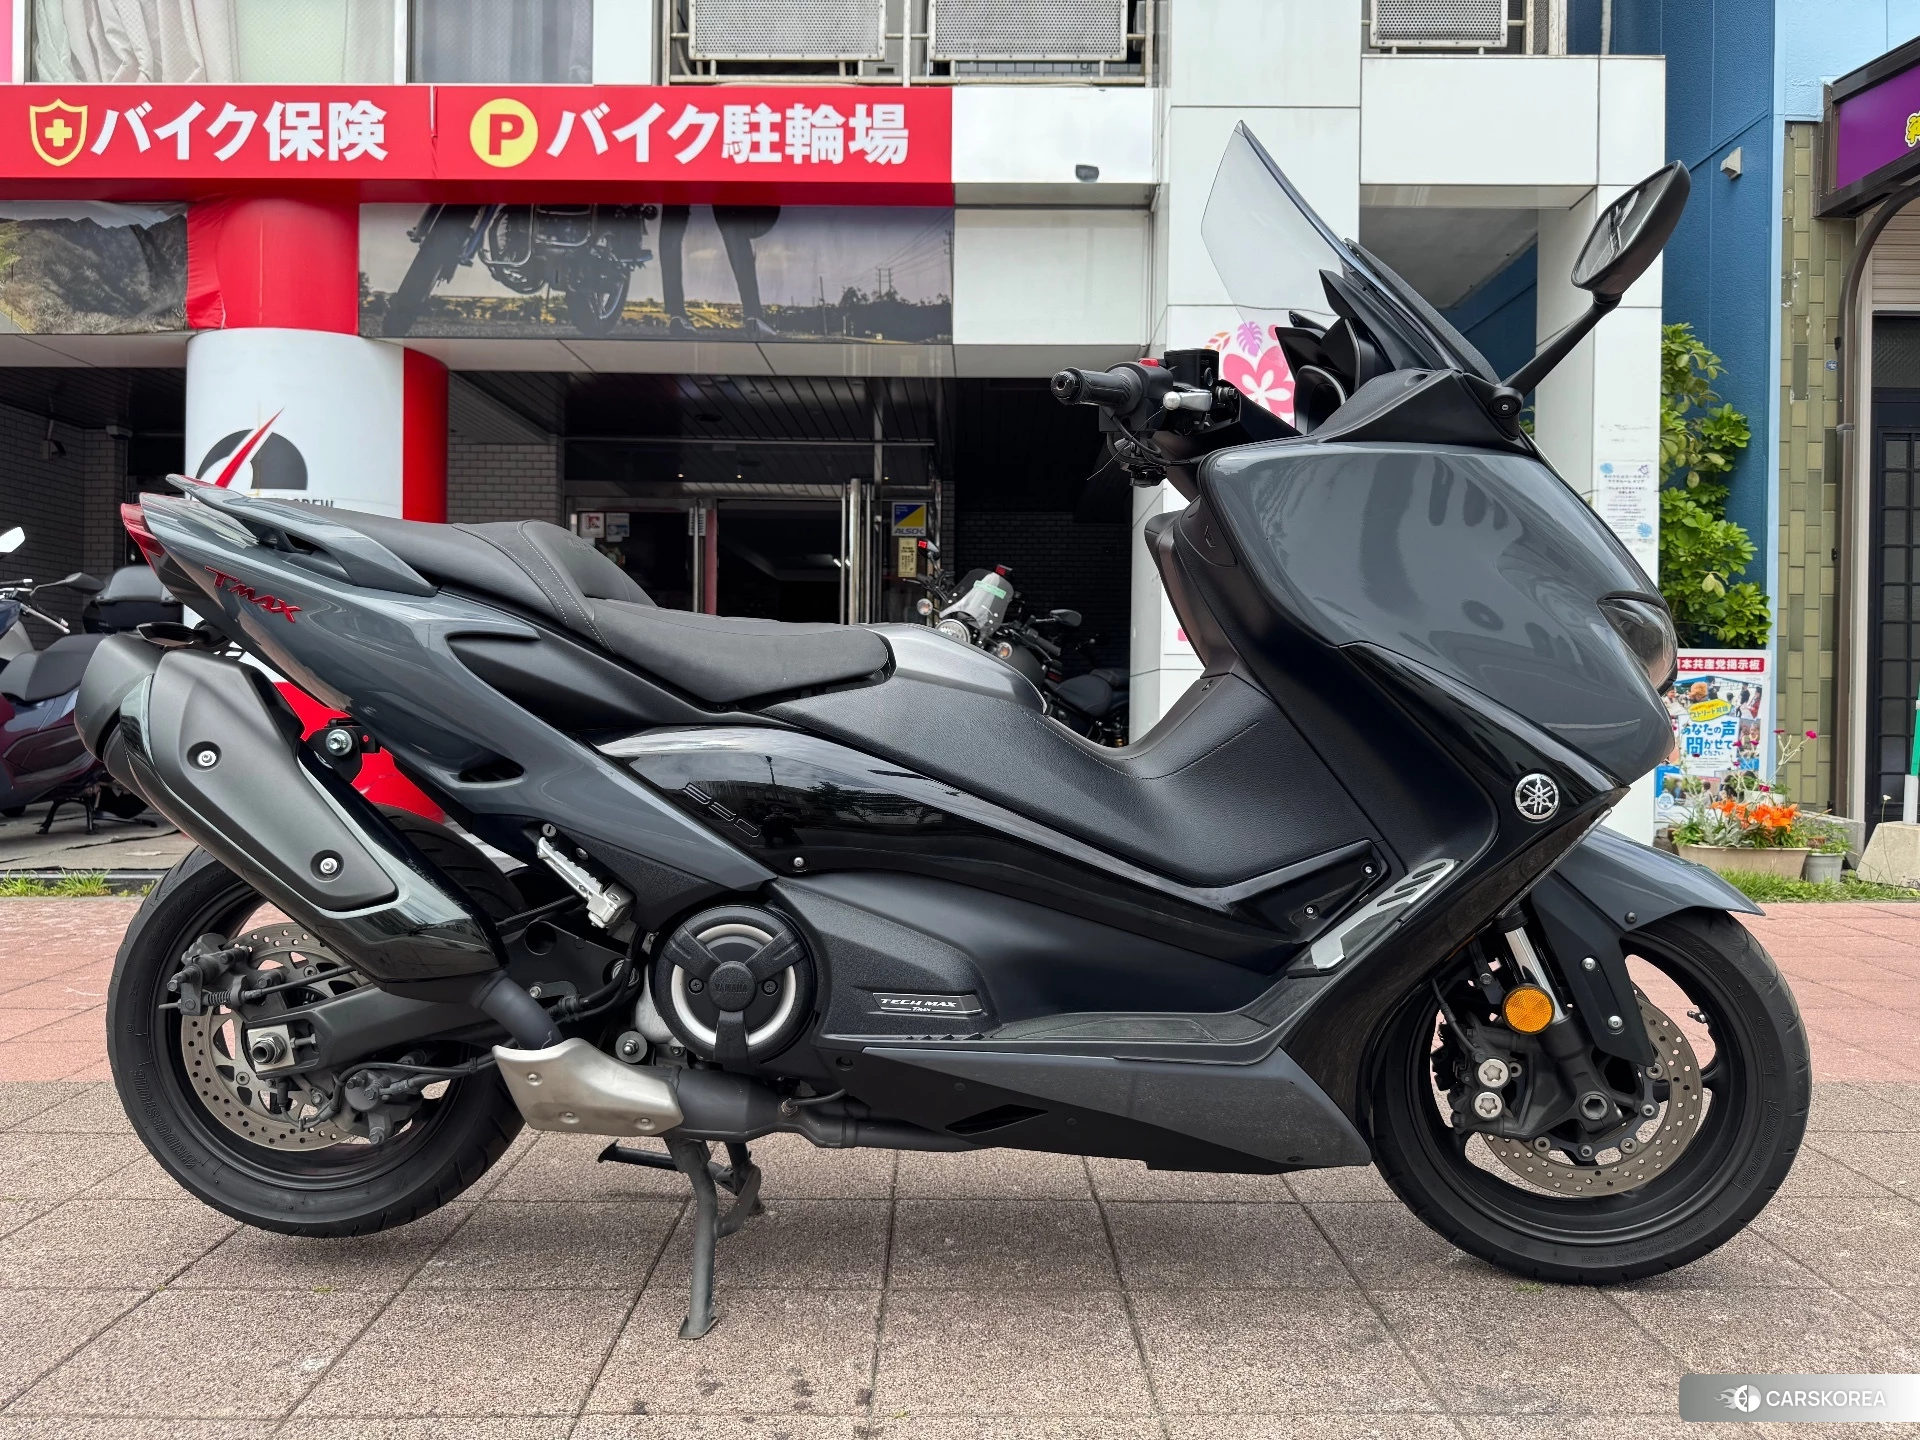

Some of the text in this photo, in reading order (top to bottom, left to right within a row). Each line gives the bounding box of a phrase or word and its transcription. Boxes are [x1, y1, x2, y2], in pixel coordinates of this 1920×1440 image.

[91, 100, 388, 162] バイク保険
[488, 102, 909, 165] P バイク駐輪場
[204, 565, 302, 623] TMAX
[1677, 658, 1761, 671] 本共産党掲示板
[1682, 720, 1738, 738] あなたの声
[714, 983, 748, 994] YAMAHA
[924, 1000, 957, 1008] MAX
